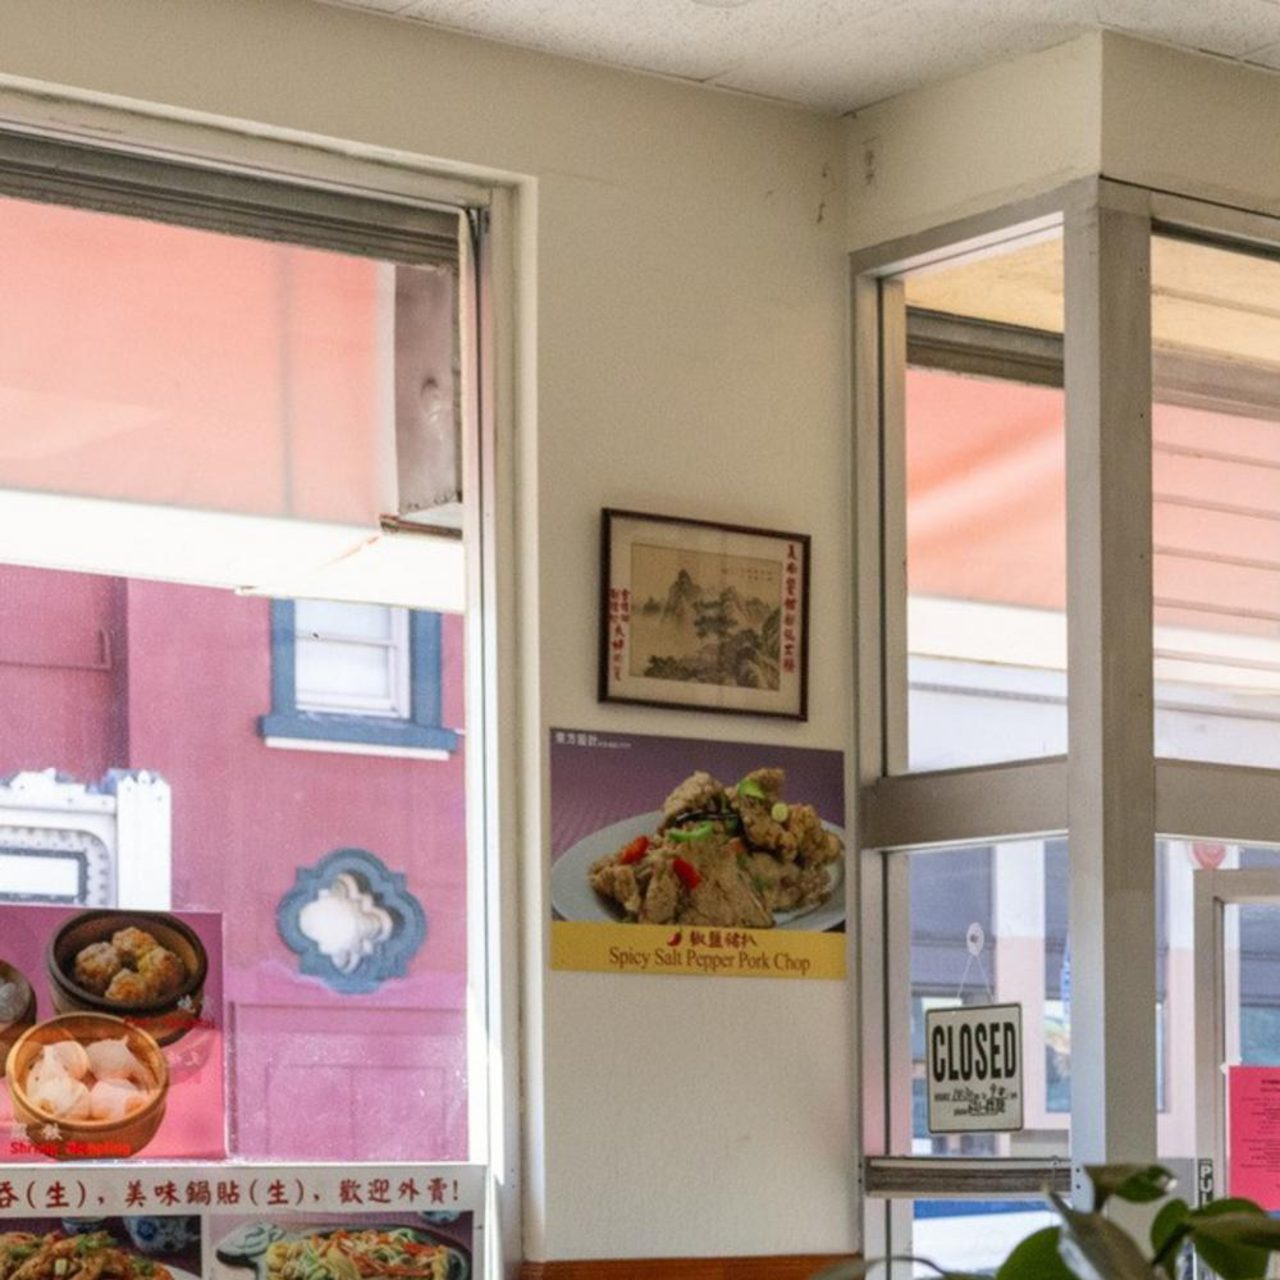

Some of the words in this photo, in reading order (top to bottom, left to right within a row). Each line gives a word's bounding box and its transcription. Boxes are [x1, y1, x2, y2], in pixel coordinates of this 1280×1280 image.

[608, 946, 651, 968] Spicy
[654, 948, 683, 967] Salt
[686, 949, 735, 972] Pepper
[738, 951, 769, 970] Pork
[773, 953, 812, 974] Chop
[932, 1021, 1017, 1083] CLOSED
